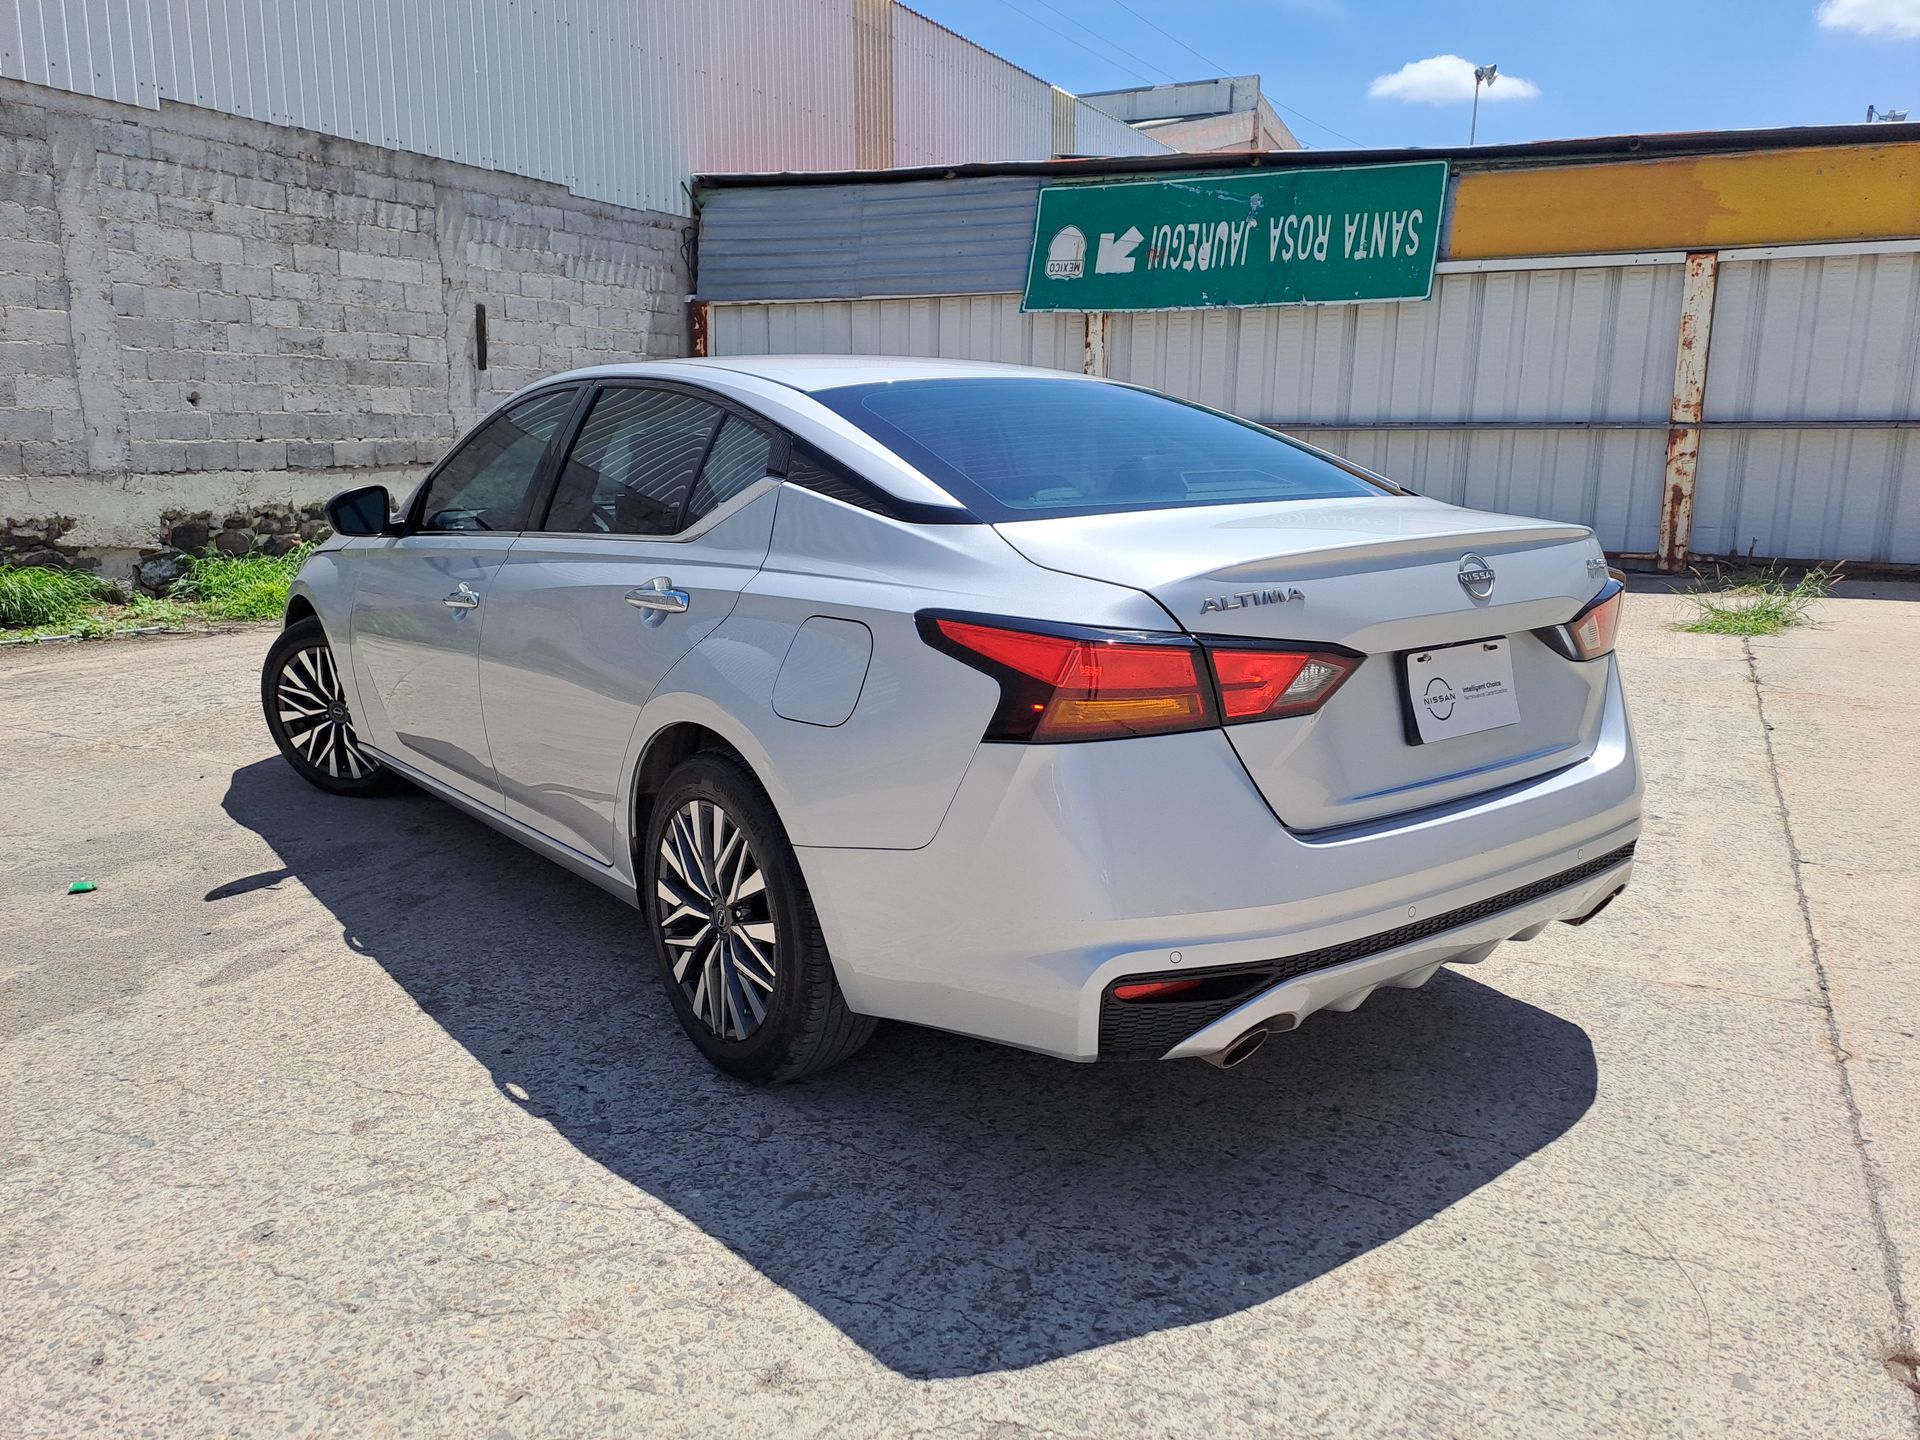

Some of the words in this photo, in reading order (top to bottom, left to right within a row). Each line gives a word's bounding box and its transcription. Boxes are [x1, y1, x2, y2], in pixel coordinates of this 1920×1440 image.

[1147, 217, 1258, 273] JAUREGUI
[1270, 214, 1332, 263] ROSA
[1344, 209, 1423, 261] SANTA
[1049, 262, 1081, 274] MEXICO
[1459, 570, 1494, 582] NISSAN
[1199, 586, 1306, 615] ALTIMA
[1462, 684, 1485, 692] Intelligent
[1423, 693, 1456, 705] NISSAN
